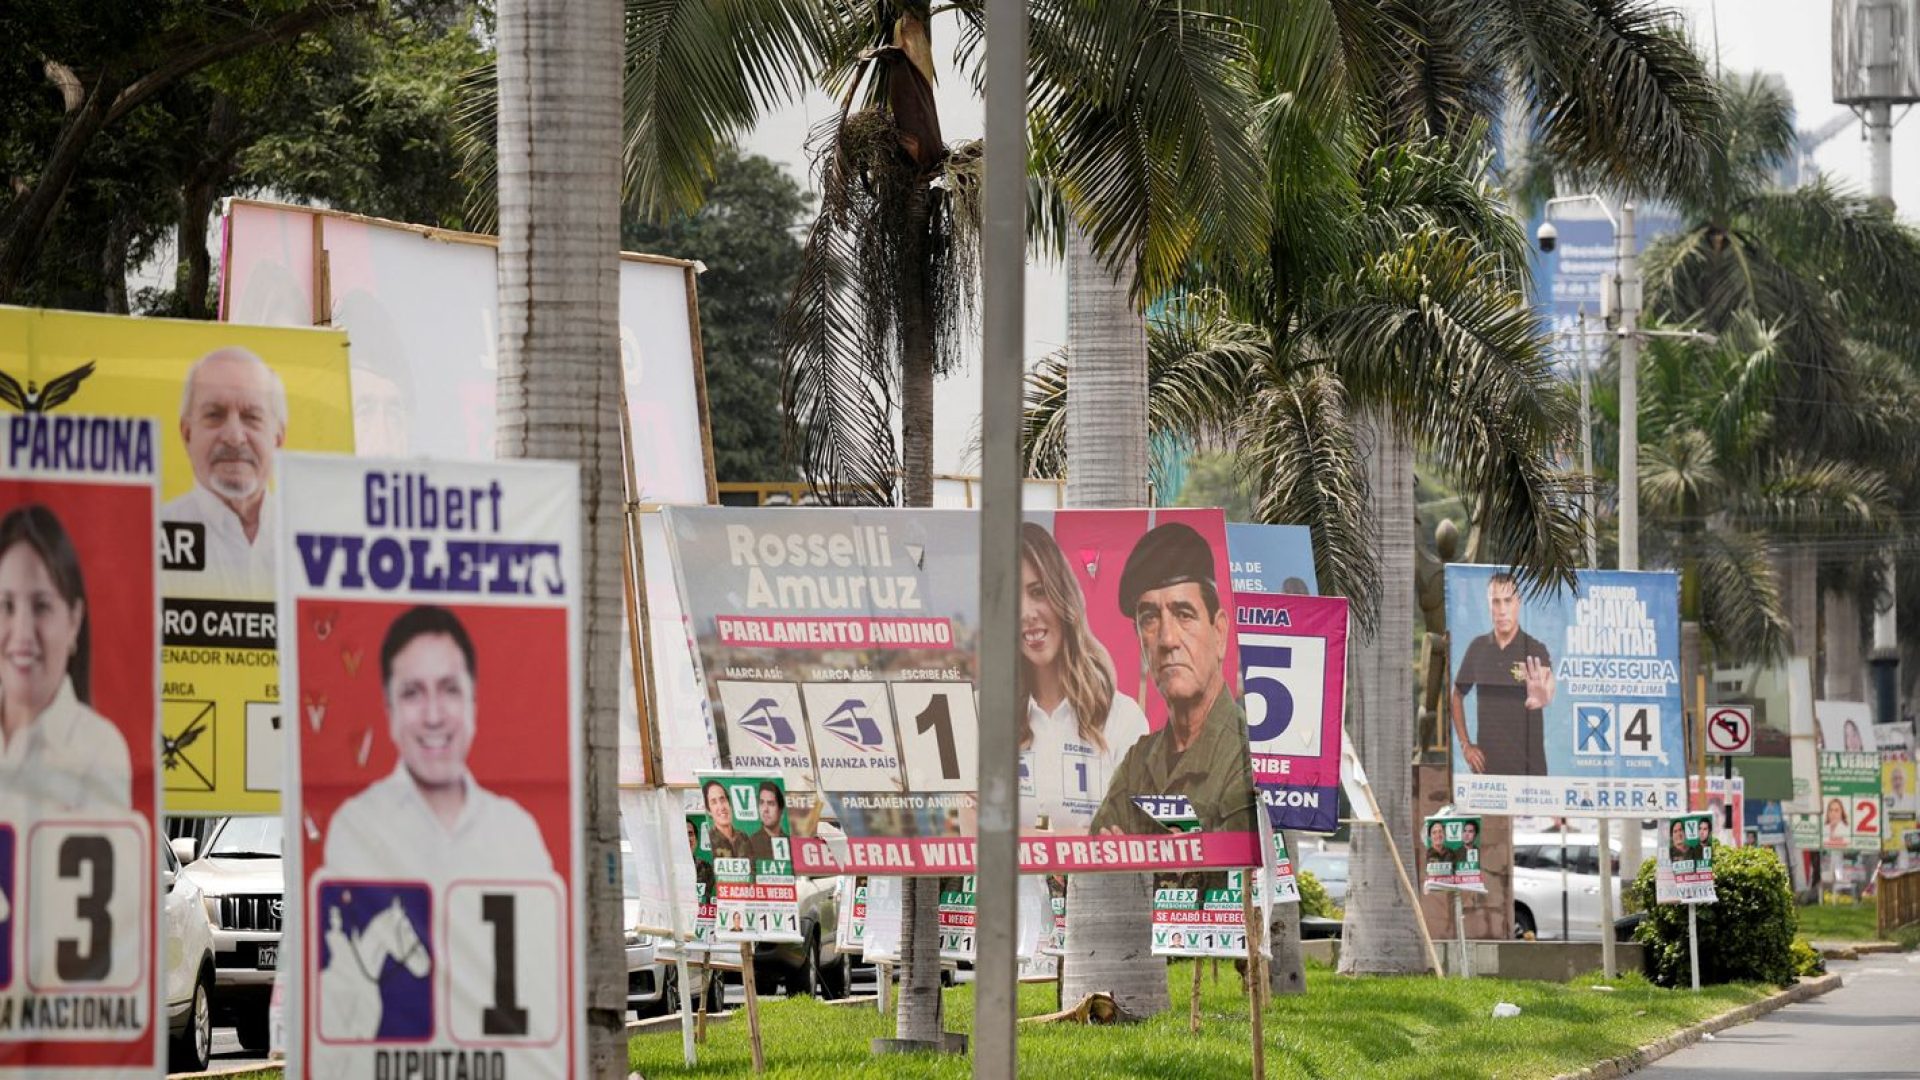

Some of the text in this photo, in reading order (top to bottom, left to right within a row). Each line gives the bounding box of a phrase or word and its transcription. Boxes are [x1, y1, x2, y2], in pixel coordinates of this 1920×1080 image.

[9, 416, 153, 473] PARIONA
[364, 472, 502, 531] Gilbert
[726, 525, 892, 567] Rosselli
[1246, 562, 1262, 573] DE
[746, 566, 921, 609] Amuruz
[1232, 579, 1267, 591] MES.
[160, 609, 276, 638] RO CATER
[1237, 607, 1290, 626] LIMA
[719, 620, 950, 645] PARLAMENTO ANDINO
[726, 668, 762, 679] MARCA
[812, 669, 849, 680] MARCA
[901, 669, 941, 681] ESCRIBE
[1560, 661, 1674, 680] ALEX SEGURA
[163, 682, 195, 695] ARCA
[1240, 645, 1294, 742] 5
[1572, 682, 1663, 694] DIPUTADO POR LIMA
[915, 694, 960, 779] 1
[1578, 708, 1652, 751] R 4
[735, 753, 810, 768] AVANZA PAÍS
[821, 754, 896, 769] AVANZA PAÍS
[1252, 758, 1290, 775] RIBE
[1075, 763, 1088, 792] 1
[1457, 786, 1465, 797] R
[1472, 782, 1507, 792] RAFAEL
[735, 788, 750, 811] V
[842, 797, 973, 810] PARLAMENTO ANDINO
[1263, 790, 1318, 808] AZON
[1566, 790, 1678, 806] R R R R 4 R
[1855, 801, 1877, 832] 2
[1450, 825, 1459, 836] V
[776, 841, 786, 858] 1
[920, 842, 1048, 868] WILMS
[1056, 839, 1204, 865] PRESIDENTE
[717, 860, 787, 875] ALEX LAY
[966, 876, 975, 892] 1
[1233, 872, 1242, 888] 1
[719, 886, 729, 897] SE
[756, 887, 765, 898] EL
[1157, 890, 1241, 902] ALEX LAY
[1286, 883, 1295, 894] 1
[947, 893, 971, 904] LAY
[56, 835, 113, 982] 3
[1156, 912, 1168, 922] SE
[1170, 910, 1200, 922] ACABÓ
[1202, 913, 1213, 922] EL
[719, 911, 728, 926] V
[746, 912, 755, 926] V
[760, 914, 768, 931] 1
[773, 912, 783, 927] V
[788, 914, 797, 931] 1
[855, 926, 864, 936] V
[950, 934, 959, 946] V
[963, 936, 972, 950] 1
[1156, 933, 1246, 949] V V 1 V 1
[482, 894, 528, 1035] 1
[21, 996, 141, 1030] NACIONAL
[375, 1050, 506, 1080] DIPUTADO
